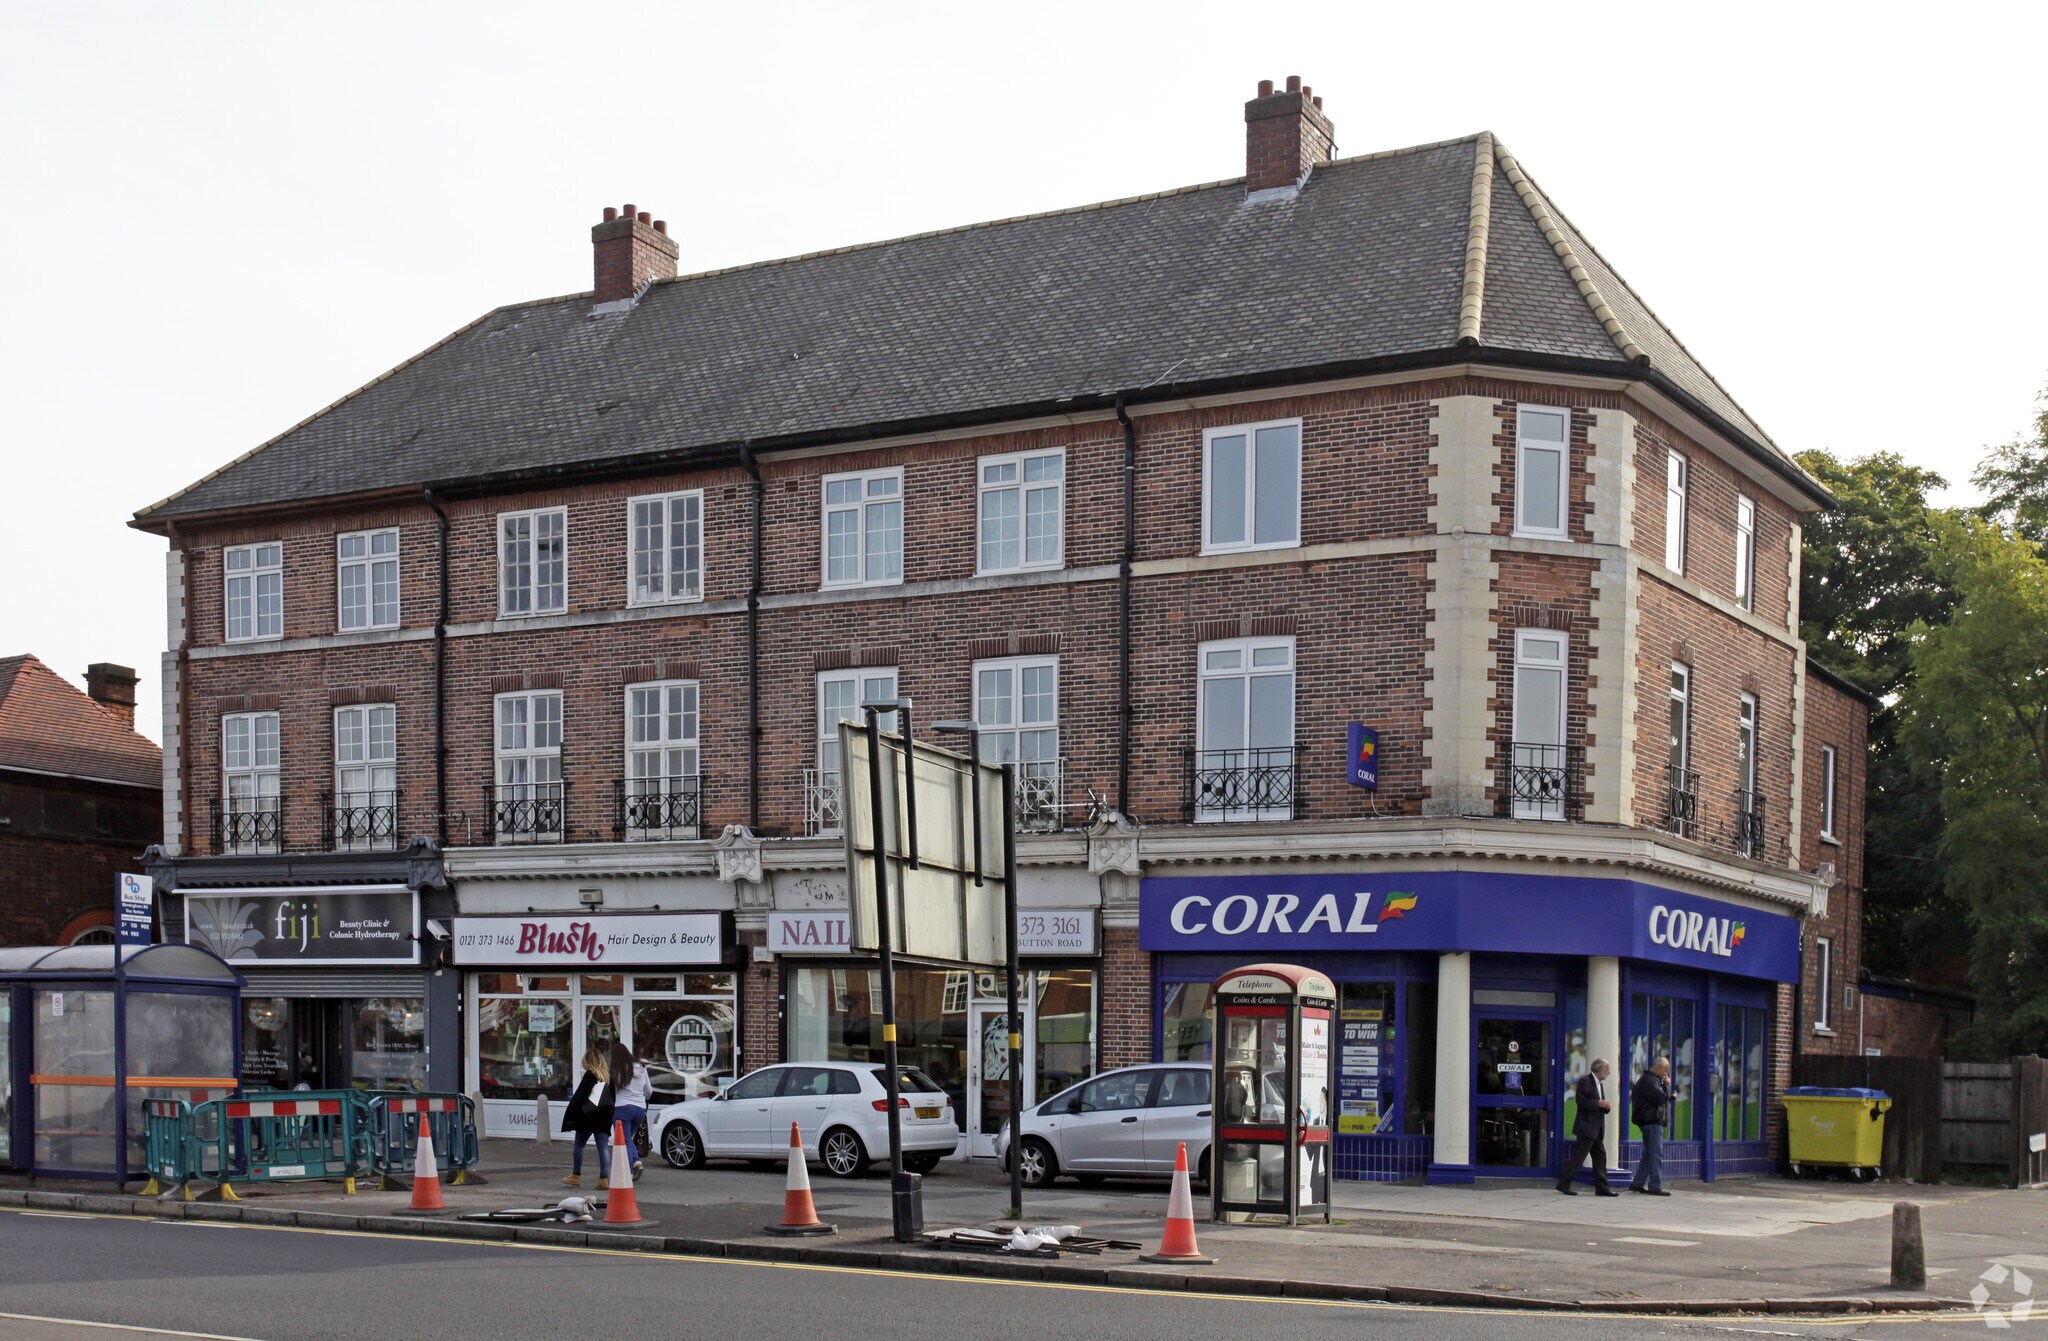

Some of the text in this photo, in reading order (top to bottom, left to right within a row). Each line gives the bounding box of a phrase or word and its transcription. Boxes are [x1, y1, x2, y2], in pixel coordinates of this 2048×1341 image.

[1358, 769, 1375, 783] CORAL
[1170, 892, 1379, 935] CORAL
[275, 901, 320, 952] fiji
[340, 919, 390, 930] Beauty Clinic &
[1020, 917, 1081, 935] 373 3161
[1649, 905, 1732, 957] CORAL
[329, 930, 400, 940] Colonic Hydrotherapy
[782, 920, 851, 945] NAIL
[459, 935, 515, 946] 0121 373 1466
[516, 922, 604, 961] Blush
[608, 933, 716, 948] Hair Design & Beauty
[1018, 939, 1082, 947] SUTTON ROAD
[1238, 980, 1273, 990] Telephone
[1309, 982, 1325, 992] Telephone
[1344, 1030, 1378, 1039] TO WIN
